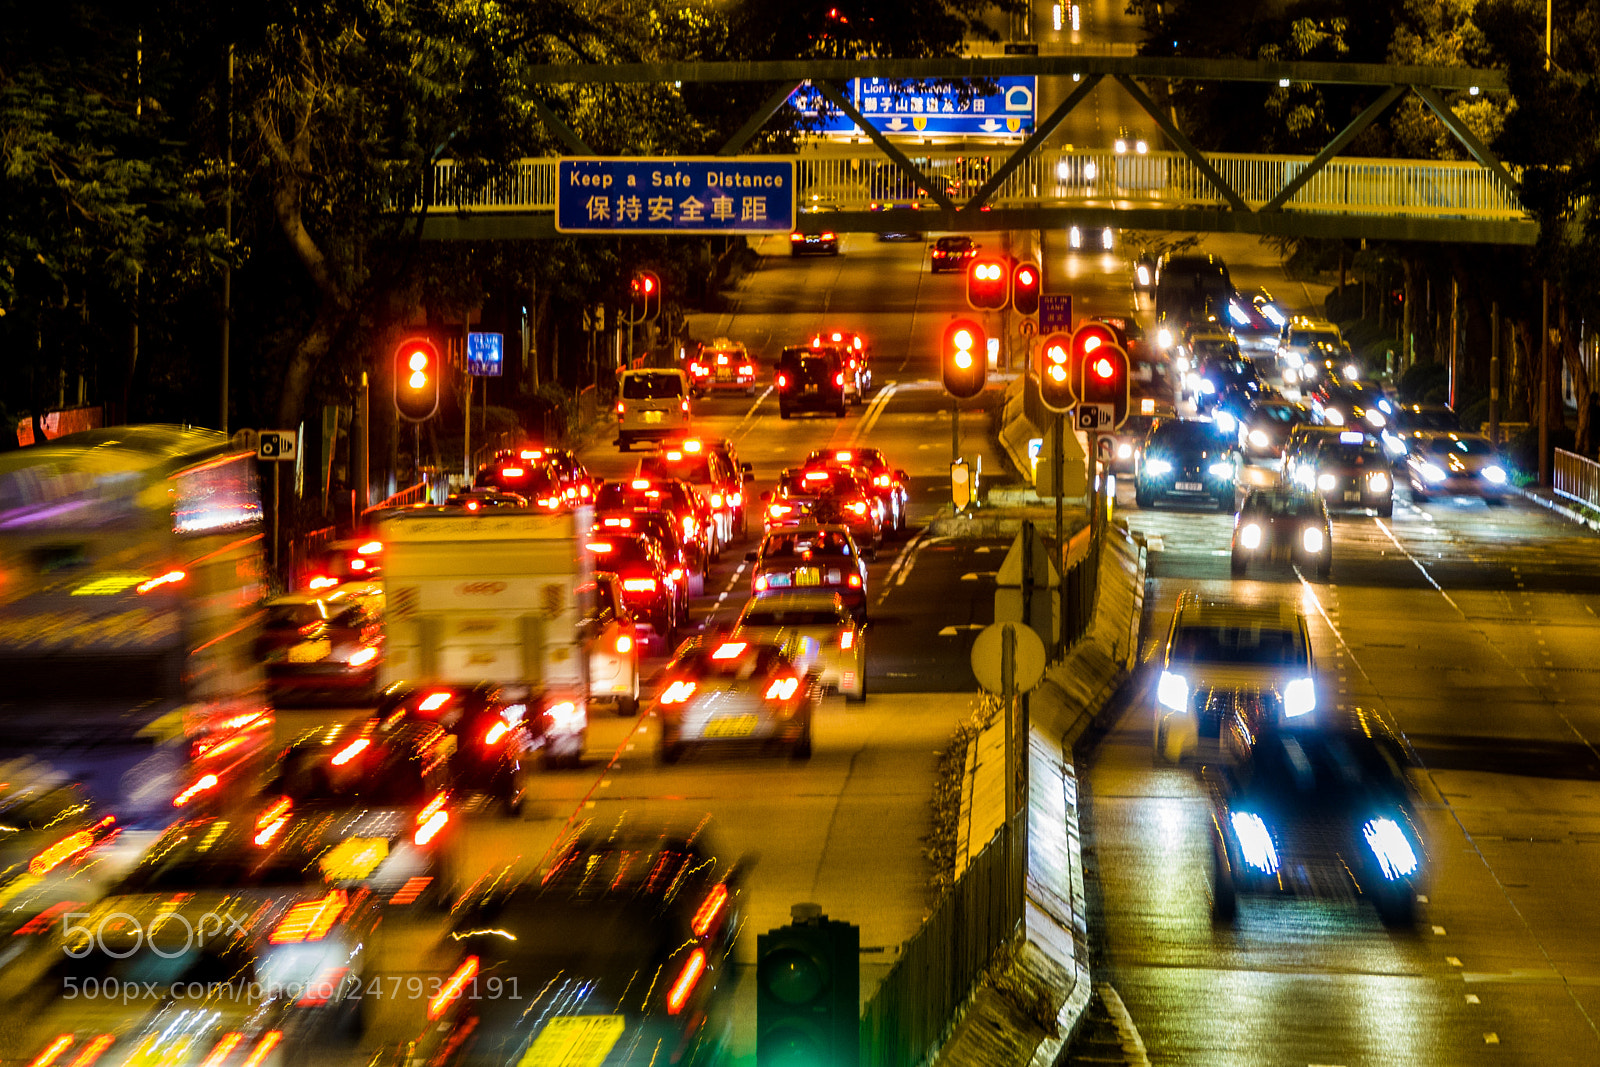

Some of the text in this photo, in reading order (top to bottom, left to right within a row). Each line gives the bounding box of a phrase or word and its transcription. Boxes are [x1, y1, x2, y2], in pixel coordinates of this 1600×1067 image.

[863, 82, 886, 94] Lion
[570, 170, 783, 189] Keep a Safe Distance
[585, 194, 768, 222] 保持安全車距
